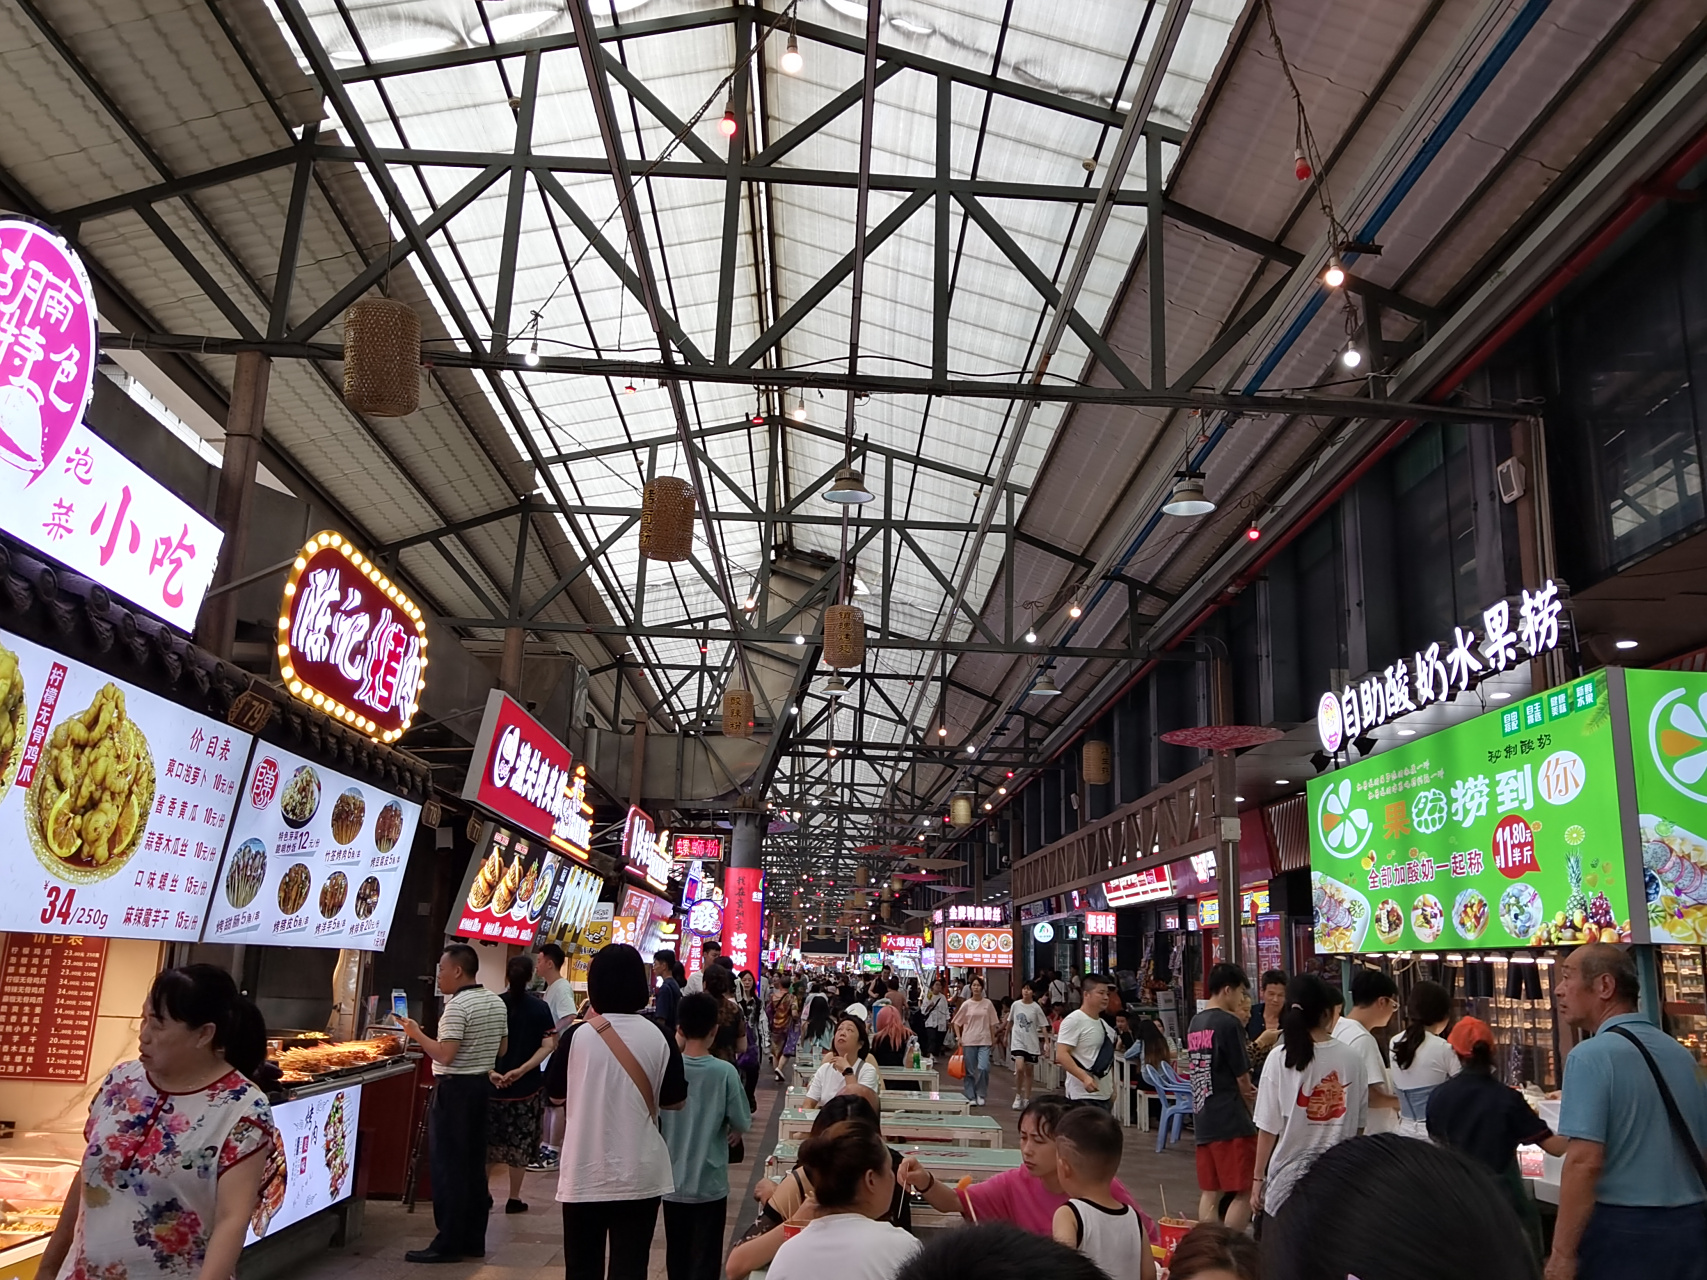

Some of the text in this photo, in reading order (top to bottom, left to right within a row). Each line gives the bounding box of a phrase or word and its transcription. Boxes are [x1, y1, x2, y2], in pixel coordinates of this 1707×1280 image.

[42, 446, 94, 541] 泡菜
[90, 485, 196, 609] 小吃
[1341, 579, 1563, 738] 自助酸奶水果捞
[18, 667, 63, 783] 柠檬无骨鸡爪
[243, 700, 265, 727] 79
[190, 727, 231, 761] 价目表
[1487, 734, 1552, 764] 秘制酸奶
[165, 757, 207, 787] 爽口泡萝卜
[212, 773, 235, 796] 10元/份
[203, 807, 226, 829] 10元/份
[144, 831, 217, 862] 蒜香木瓜丝 10元/份
[676, 838, 719, 857] 螺蛳粉
[1512, 847, 1533, 866] 半斤
[134, 870, 208, 896] 口味螺丝 15元/份
[1367, 848, 1485, 890] 全部加酸奶一起称
[122, 905, 199, 931] 麻辣魔芋干 15元/份
[1087, 914, 1115, 933] 便利店
[730, 932, 747, 977] 螺蛳
